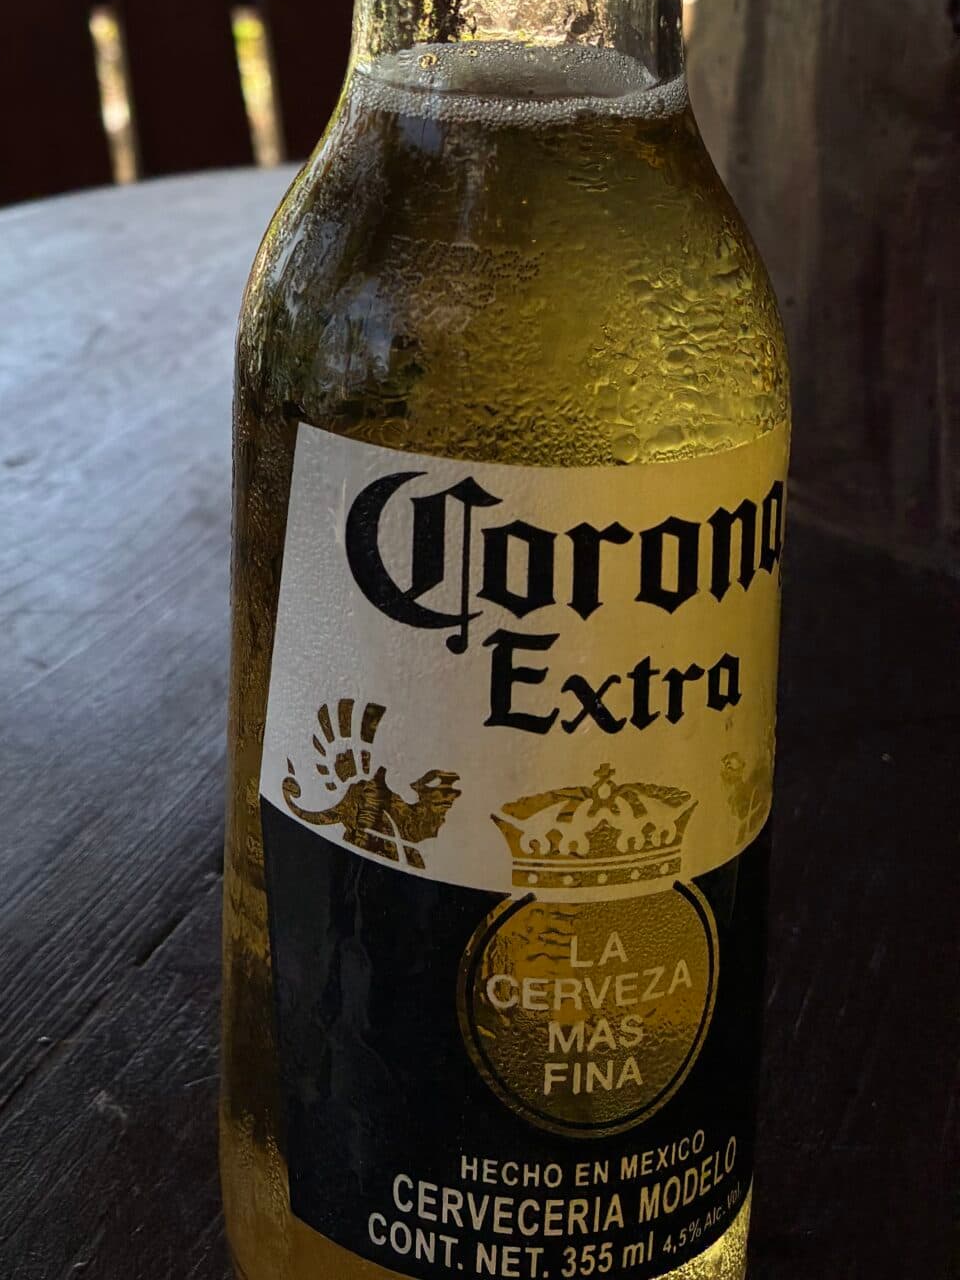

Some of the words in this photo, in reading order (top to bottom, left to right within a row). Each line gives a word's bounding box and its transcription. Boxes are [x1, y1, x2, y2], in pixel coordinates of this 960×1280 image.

[345, 471, 784, 654] Corona
[482, 629, 742, 735] Extra
[569, 931, 629, 968] LA
[486, 959, 693, 1010] CERVEZA
[548, 1014, 645, 1054] MAS
[543, 1056, 644, 1096] FINA
[393, 1173, 625, 1237] CERVECERIA
[639, 1136, 737, 1224] MODELO
[461, 1154, 564, 1188] HECHO
[575, 1161, 609, 1187] EN
[620, 1129, 705, 1180] MEXICO
[368, 1212, 464, 1271] CONT.
[476, 1245, 550, 1280] NET.
[561, 1242, 613, 1278] 355
[622, 1231, 654, 1268] ml
